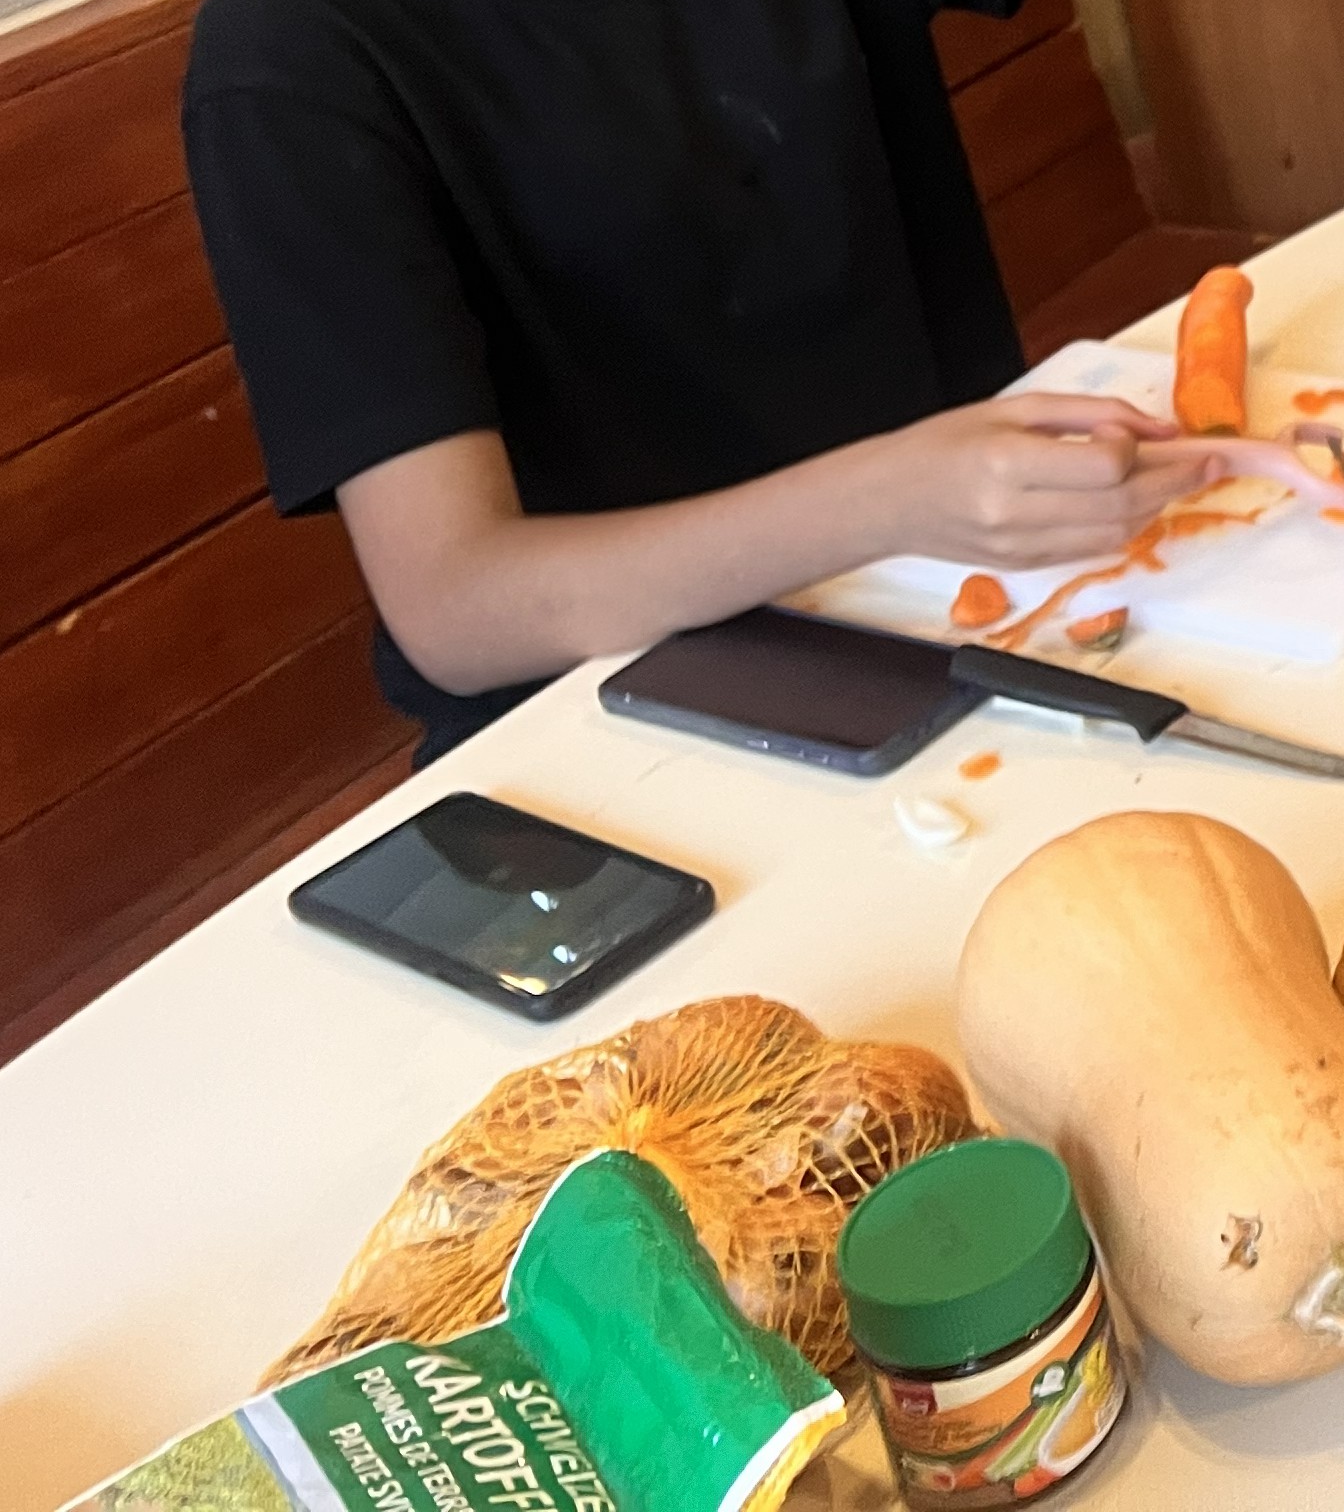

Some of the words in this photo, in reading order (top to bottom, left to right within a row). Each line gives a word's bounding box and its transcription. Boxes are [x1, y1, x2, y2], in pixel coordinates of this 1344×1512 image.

[329, 1421, 392, 1486] PATATE
[353, 1365, 423, 1445] POMMES
[398, 1441, 439, 1468] DE
[404, 1353, 560, 1512] KARTOFF
